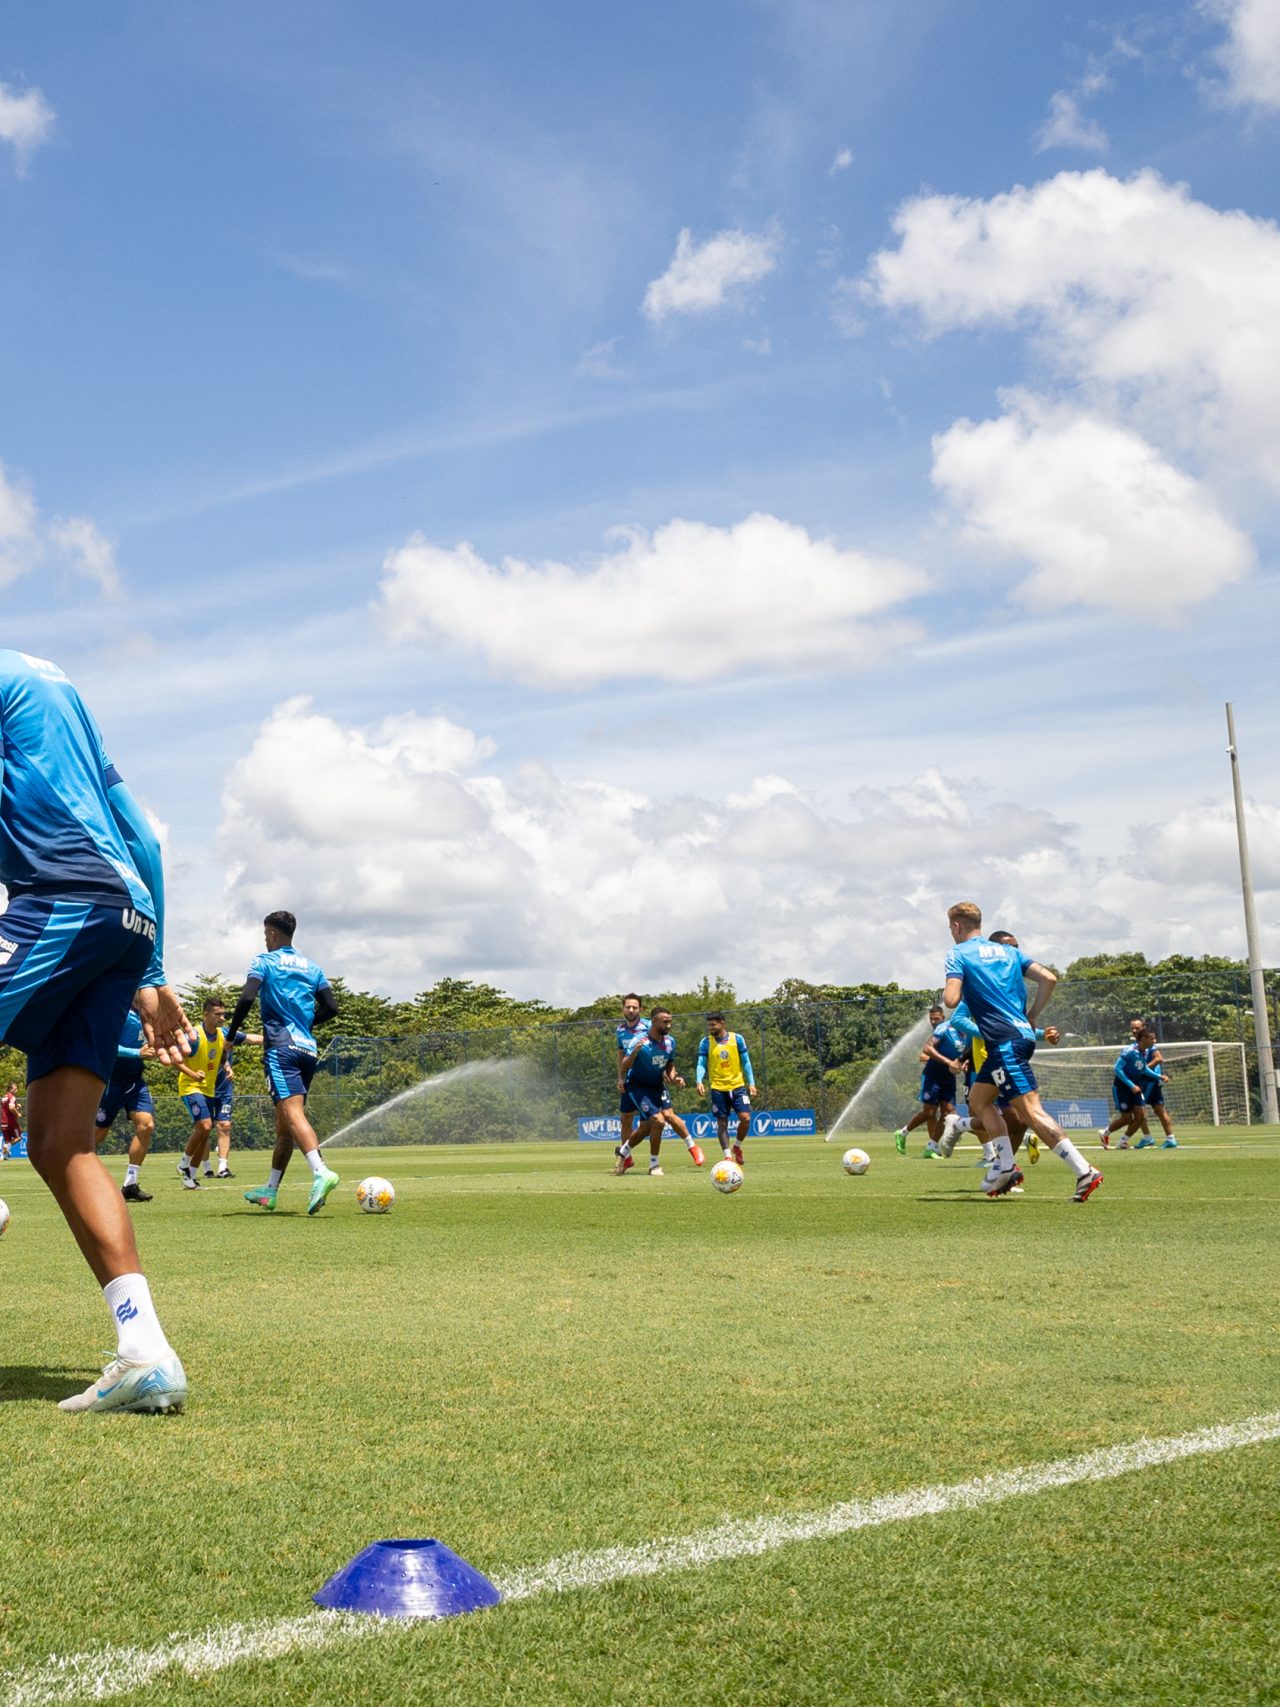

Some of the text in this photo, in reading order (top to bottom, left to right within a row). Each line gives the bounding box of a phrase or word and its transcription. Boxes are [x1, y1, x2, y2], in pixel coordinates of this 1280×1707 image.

[582, 1120, 604, 1133] VAPT
[773, 1117, 813, 1128] VITALMED
[1058, 1113, 1093, 1128] ITAIPAVA
